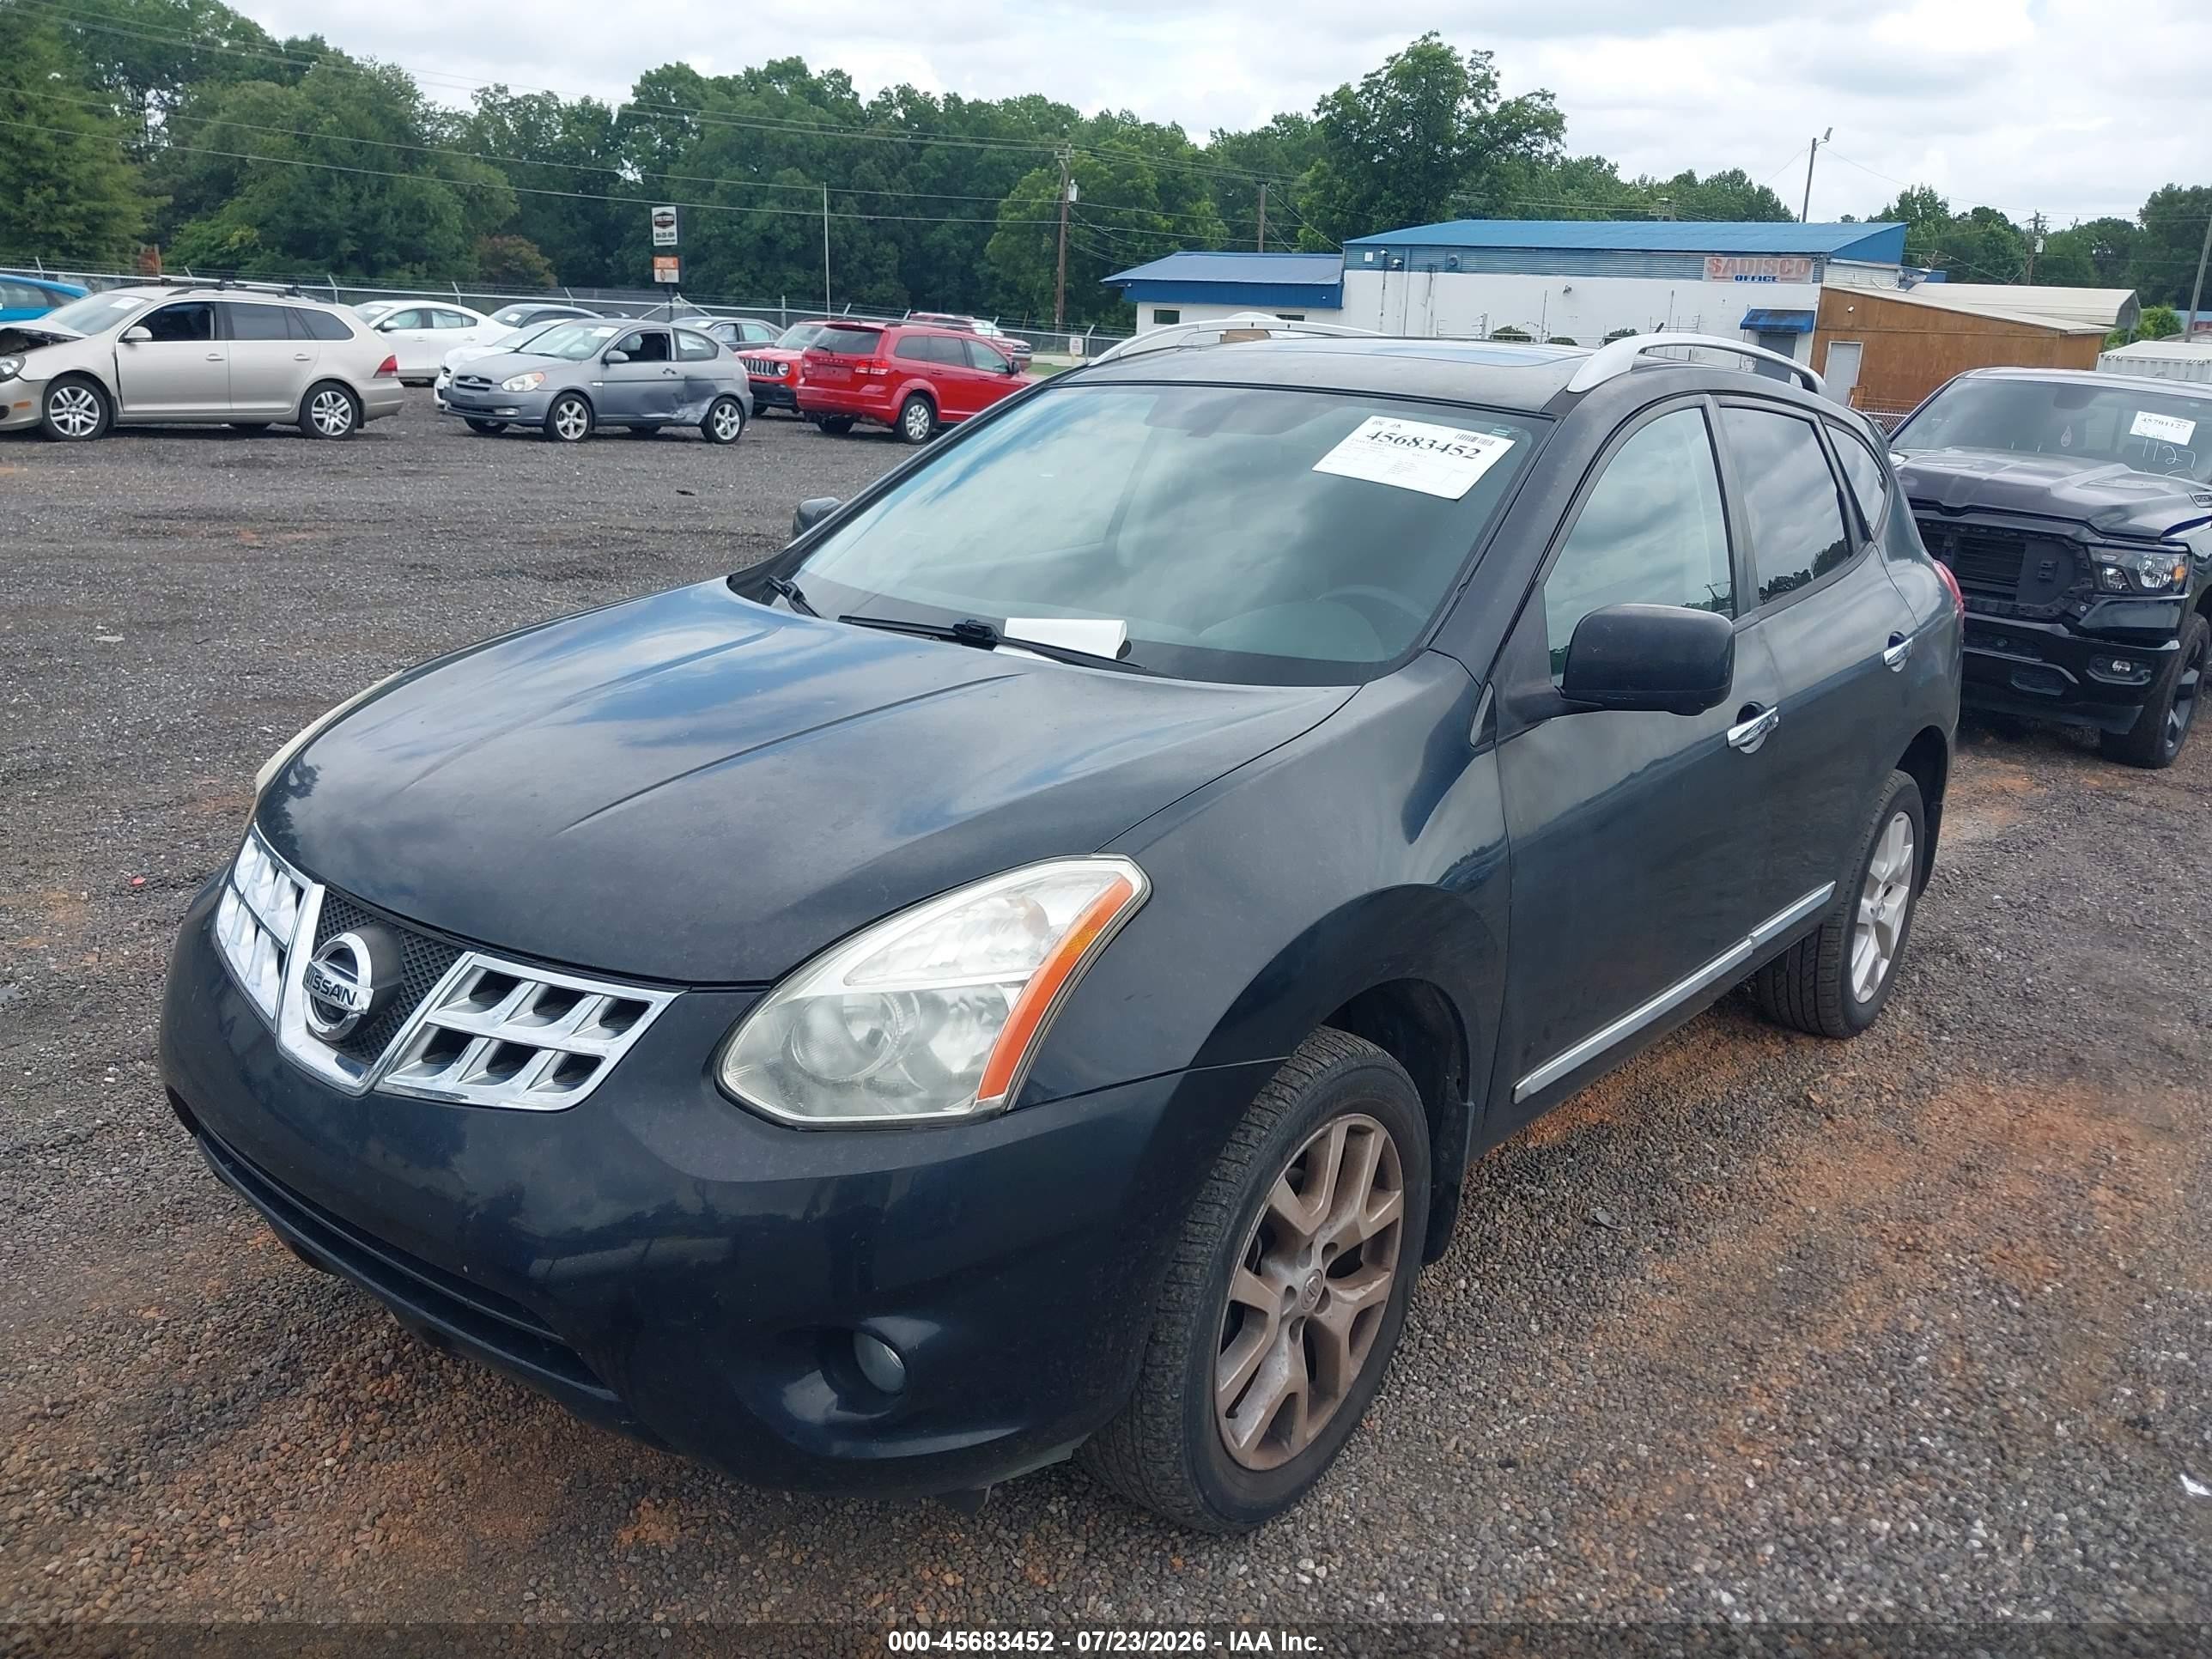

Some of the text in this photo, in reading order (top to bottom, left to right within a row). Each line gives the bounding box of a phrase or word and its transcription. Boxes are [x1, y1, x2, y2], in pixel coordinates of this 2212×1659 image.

[1707, 258, 1812, 275] SADISCO
[1366, 430, 1482, 460] 45683452
[305, 968, 357, 1006] NISSAN
